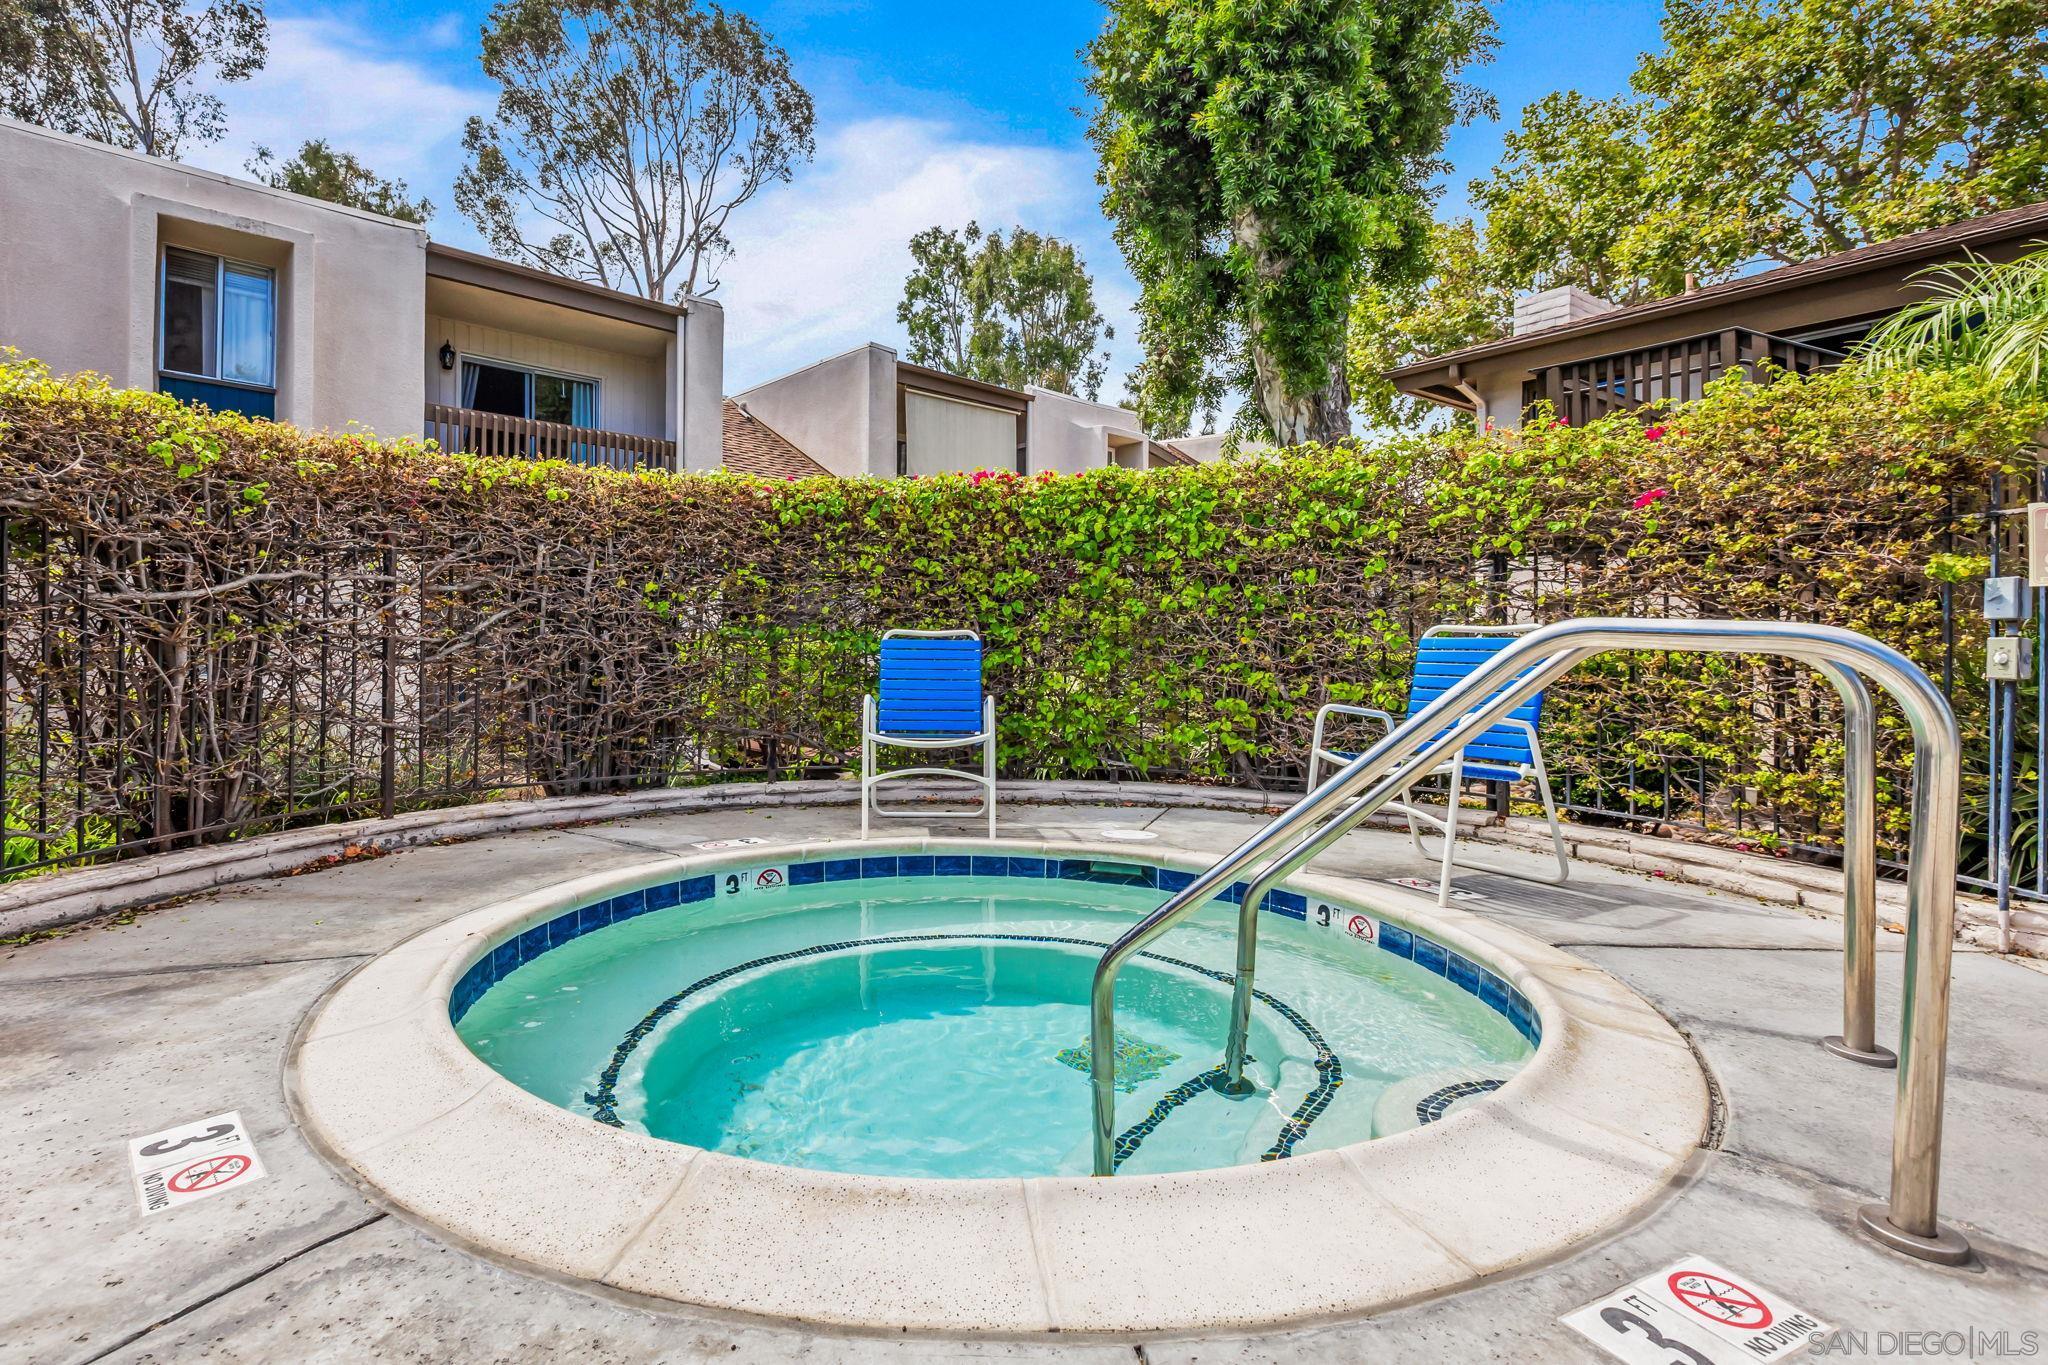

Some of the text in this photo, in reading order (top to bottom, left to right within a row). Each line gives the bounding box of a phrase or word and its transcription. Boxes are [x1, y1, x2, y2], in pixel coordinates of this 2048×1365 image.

[726, 872, 748, 894] 3 FT
[1316, 904, 1341, 927] 3 FT
[139, 1123, 241, 1157] 3 FT
[142, 1171, 170, 1211] NO DIVING
[1600, 1294, 1716, 1365] 3 FT
[1743, 1314, 1818, 1357] NO DIVING
